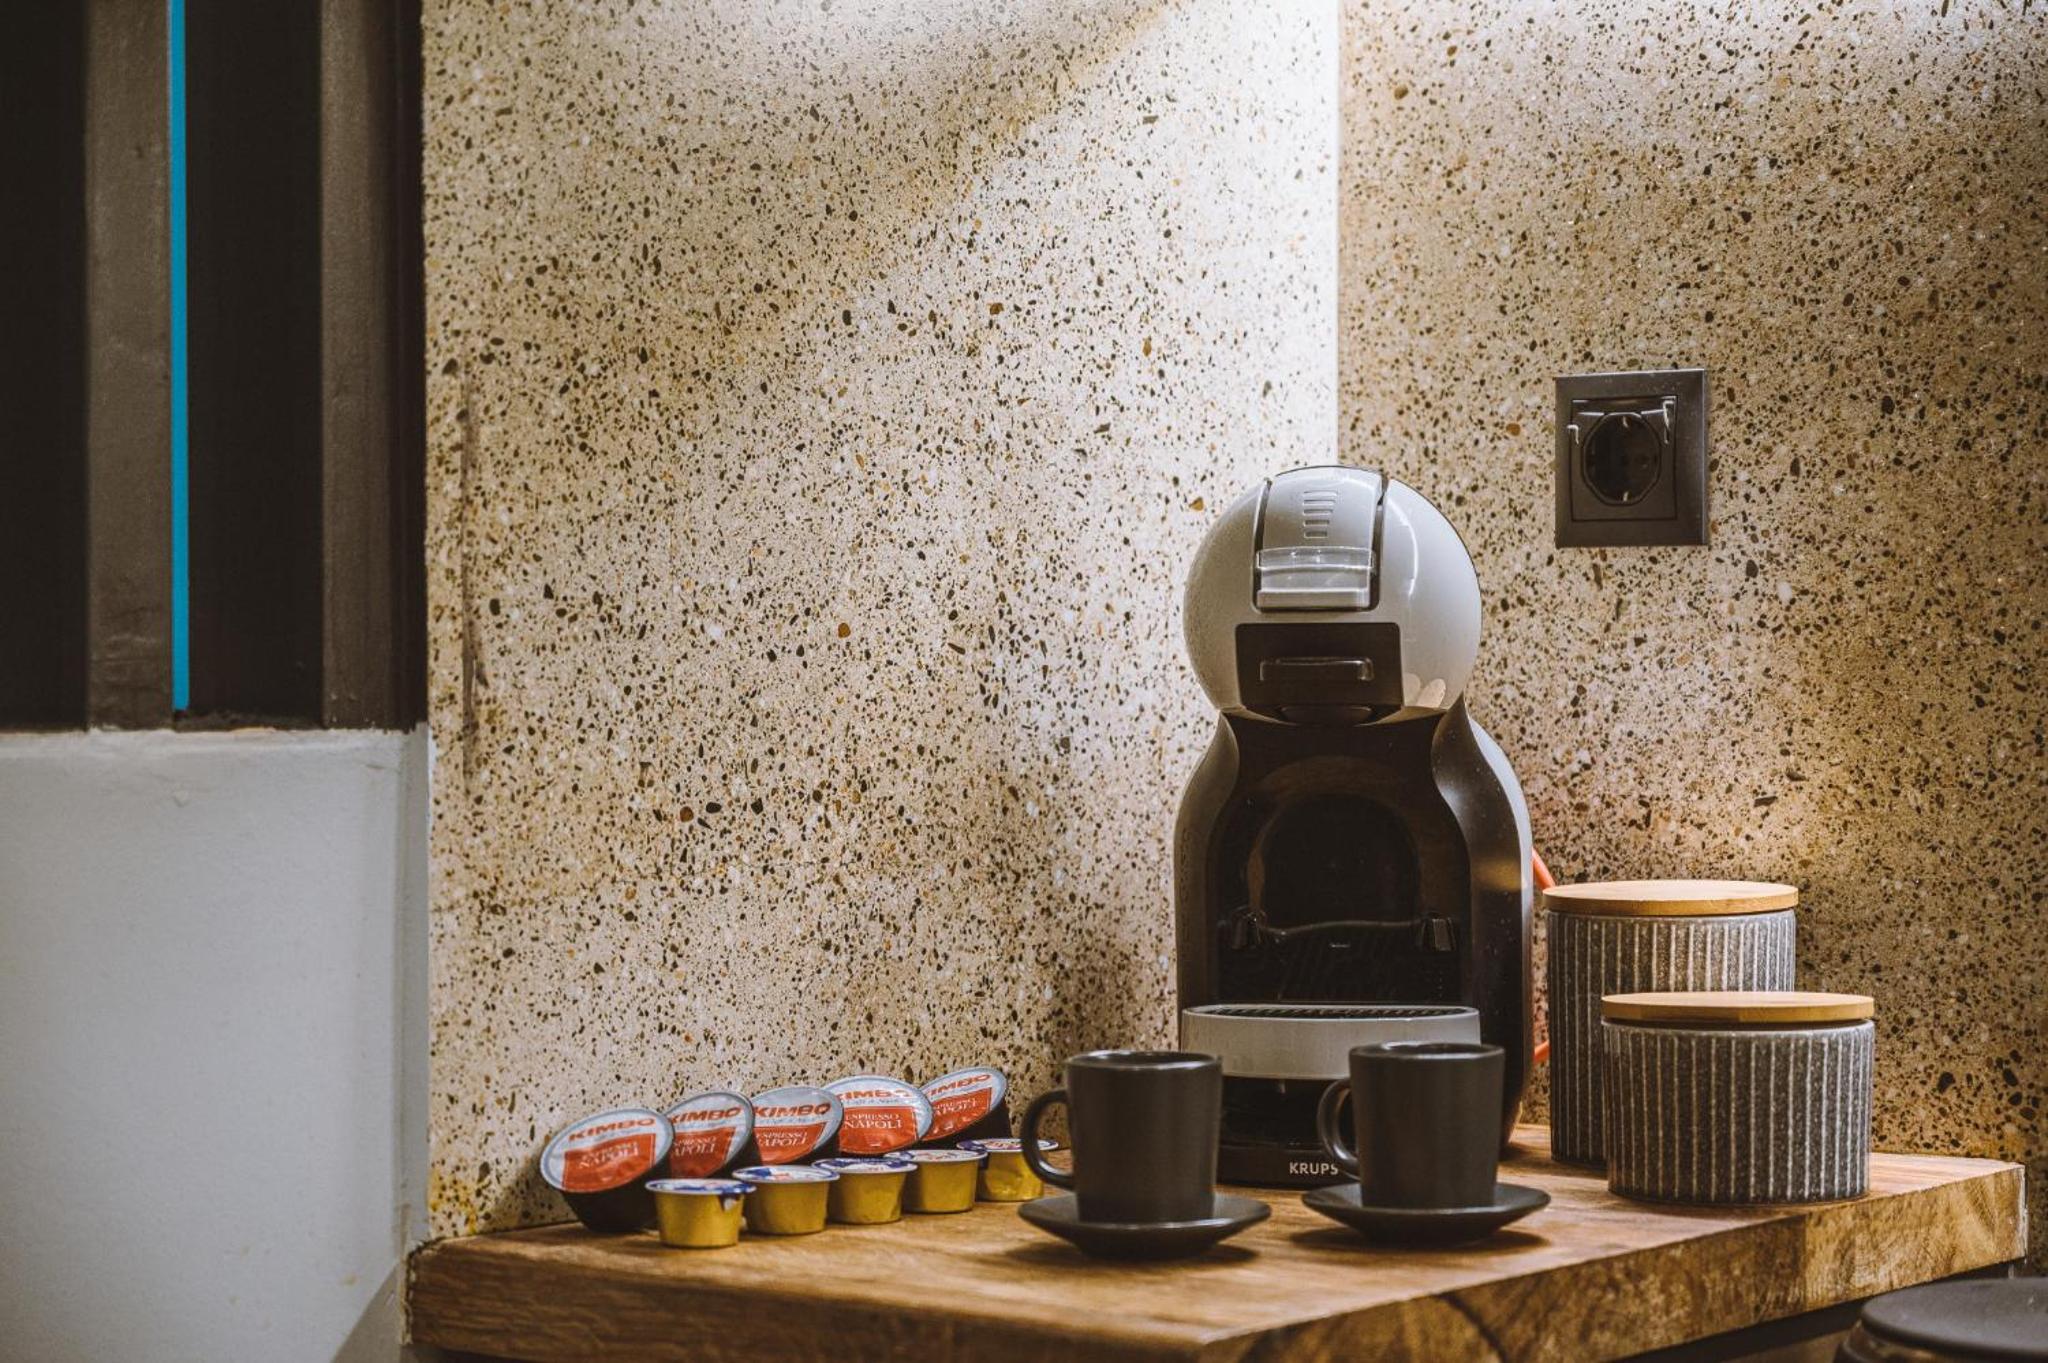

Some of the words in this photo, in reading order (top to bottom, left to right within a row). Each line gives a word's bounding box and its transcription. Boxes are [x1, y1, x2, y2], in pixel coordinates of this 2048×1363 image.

[754, 1103, 832, 1118] KIMBO
[845, 1113, 901, 1121] ESPRESSO
[567, 1118, 656, 1142] KIMBO
[844, 1119, 903, 1129] NAPOLI
[1289, 1162, 1339, 1175] KRUPS
